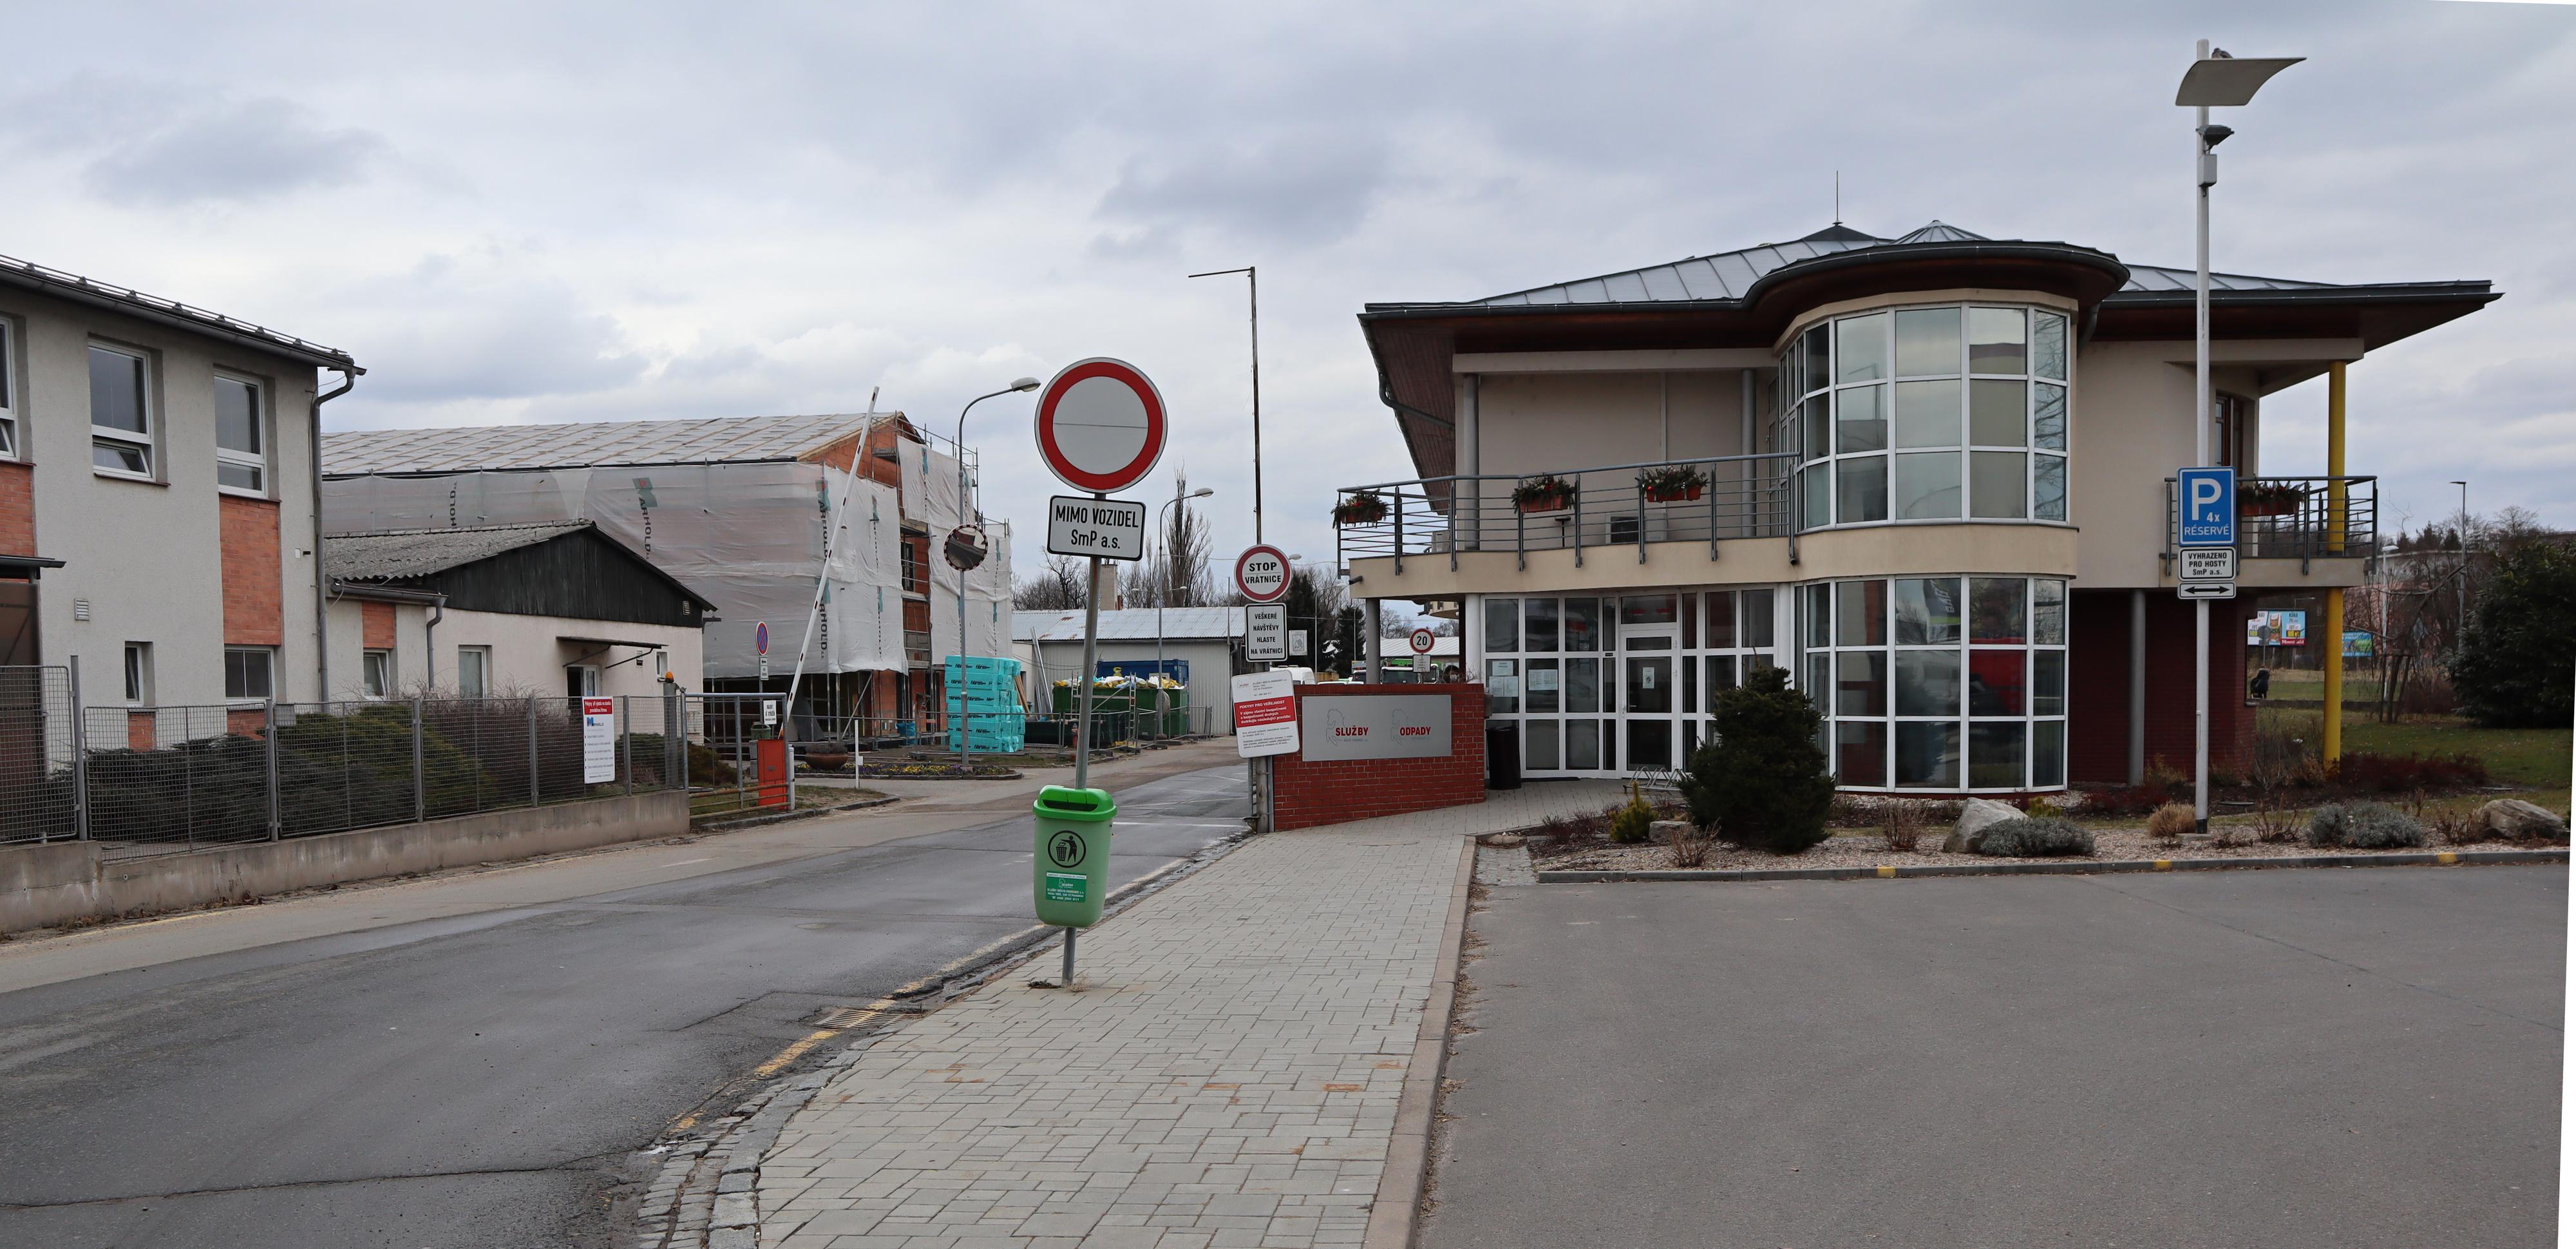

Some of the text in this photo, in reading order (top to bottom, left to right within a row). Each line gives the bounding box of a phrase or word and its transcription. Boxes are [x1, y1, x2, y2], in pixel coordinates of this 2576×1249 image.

[2192, 478, 2222, 520] P
[1055, 505, 1139, 528] MIMO VOZIDEL
[2206, 512, 2220, 522] 4x
[2184, 524, 2230, 536] RÉSERVÉ
[1070, 529, 1121, 549] SmP a.s.
[1249, 562, 1277, 572] STOP
[1245, 573, 1282, 584] VRÁTNICE
[1416, 636, 1428, 646] 20
[1335, 725, 1431, 736] SLUŽBY ODPADY
